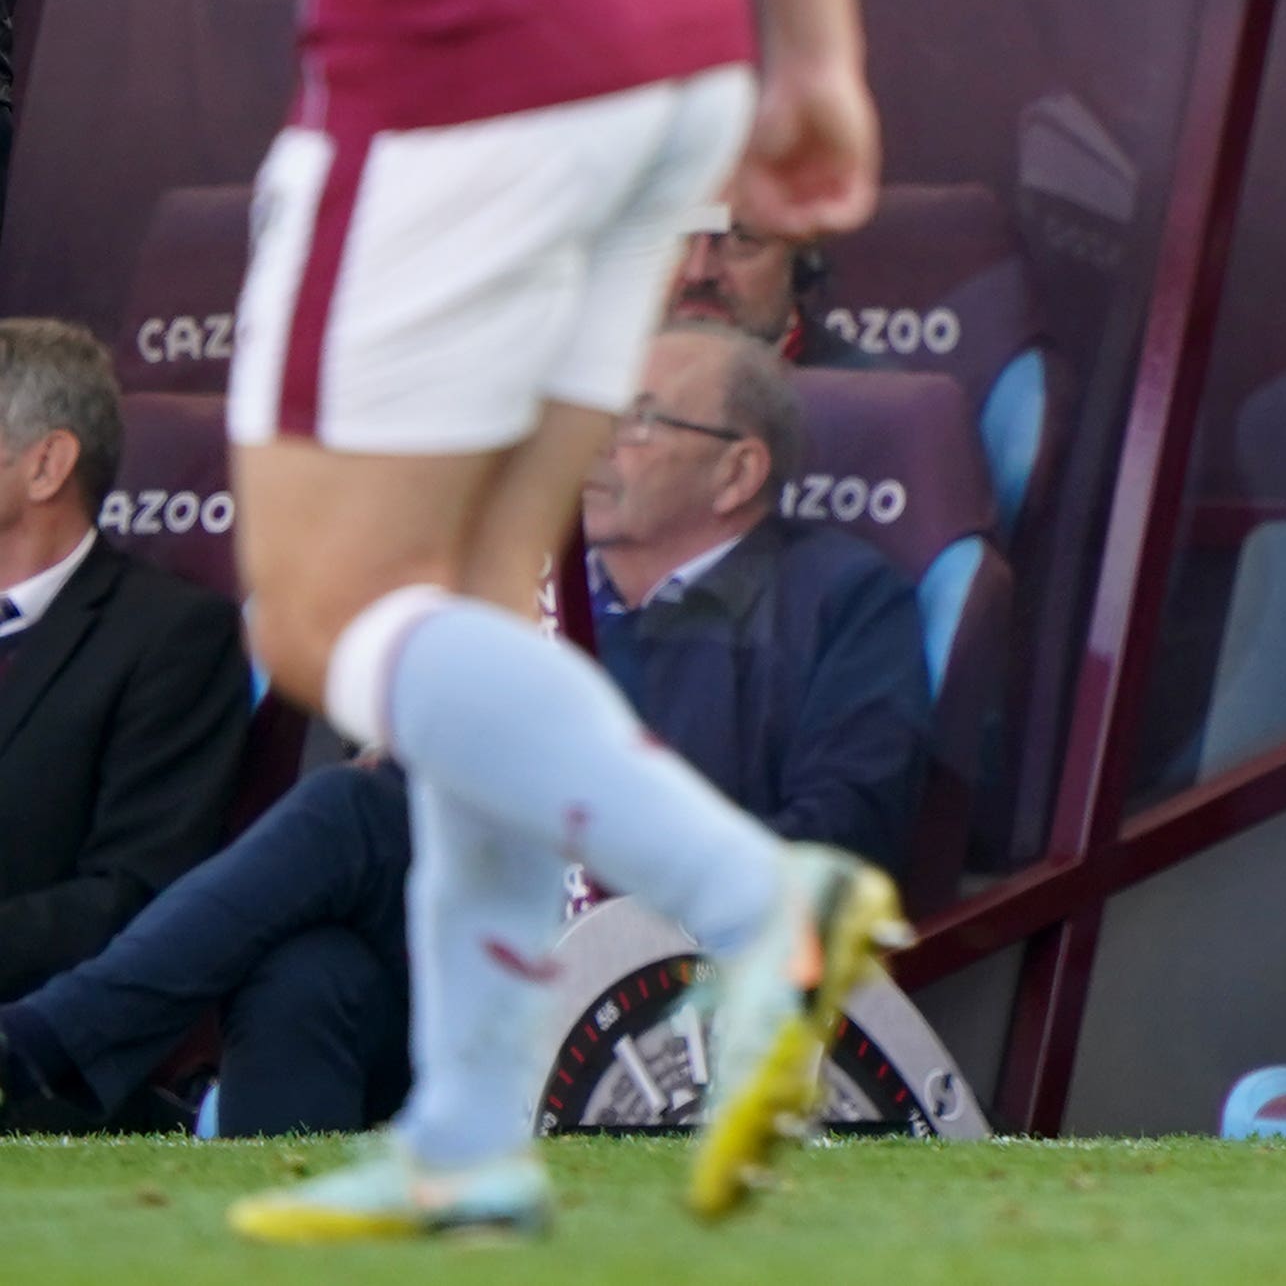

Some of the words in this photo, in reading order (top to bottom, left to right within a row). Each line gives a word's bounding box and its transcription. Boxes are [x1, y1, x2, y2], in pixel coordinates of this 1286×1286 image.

[137, 314, 235, 364] CAZ
[825, 307, 962, 355] ZOO
[99, 490, 236, 535] AZOO
[781, 479, 907, 525] ZOO
